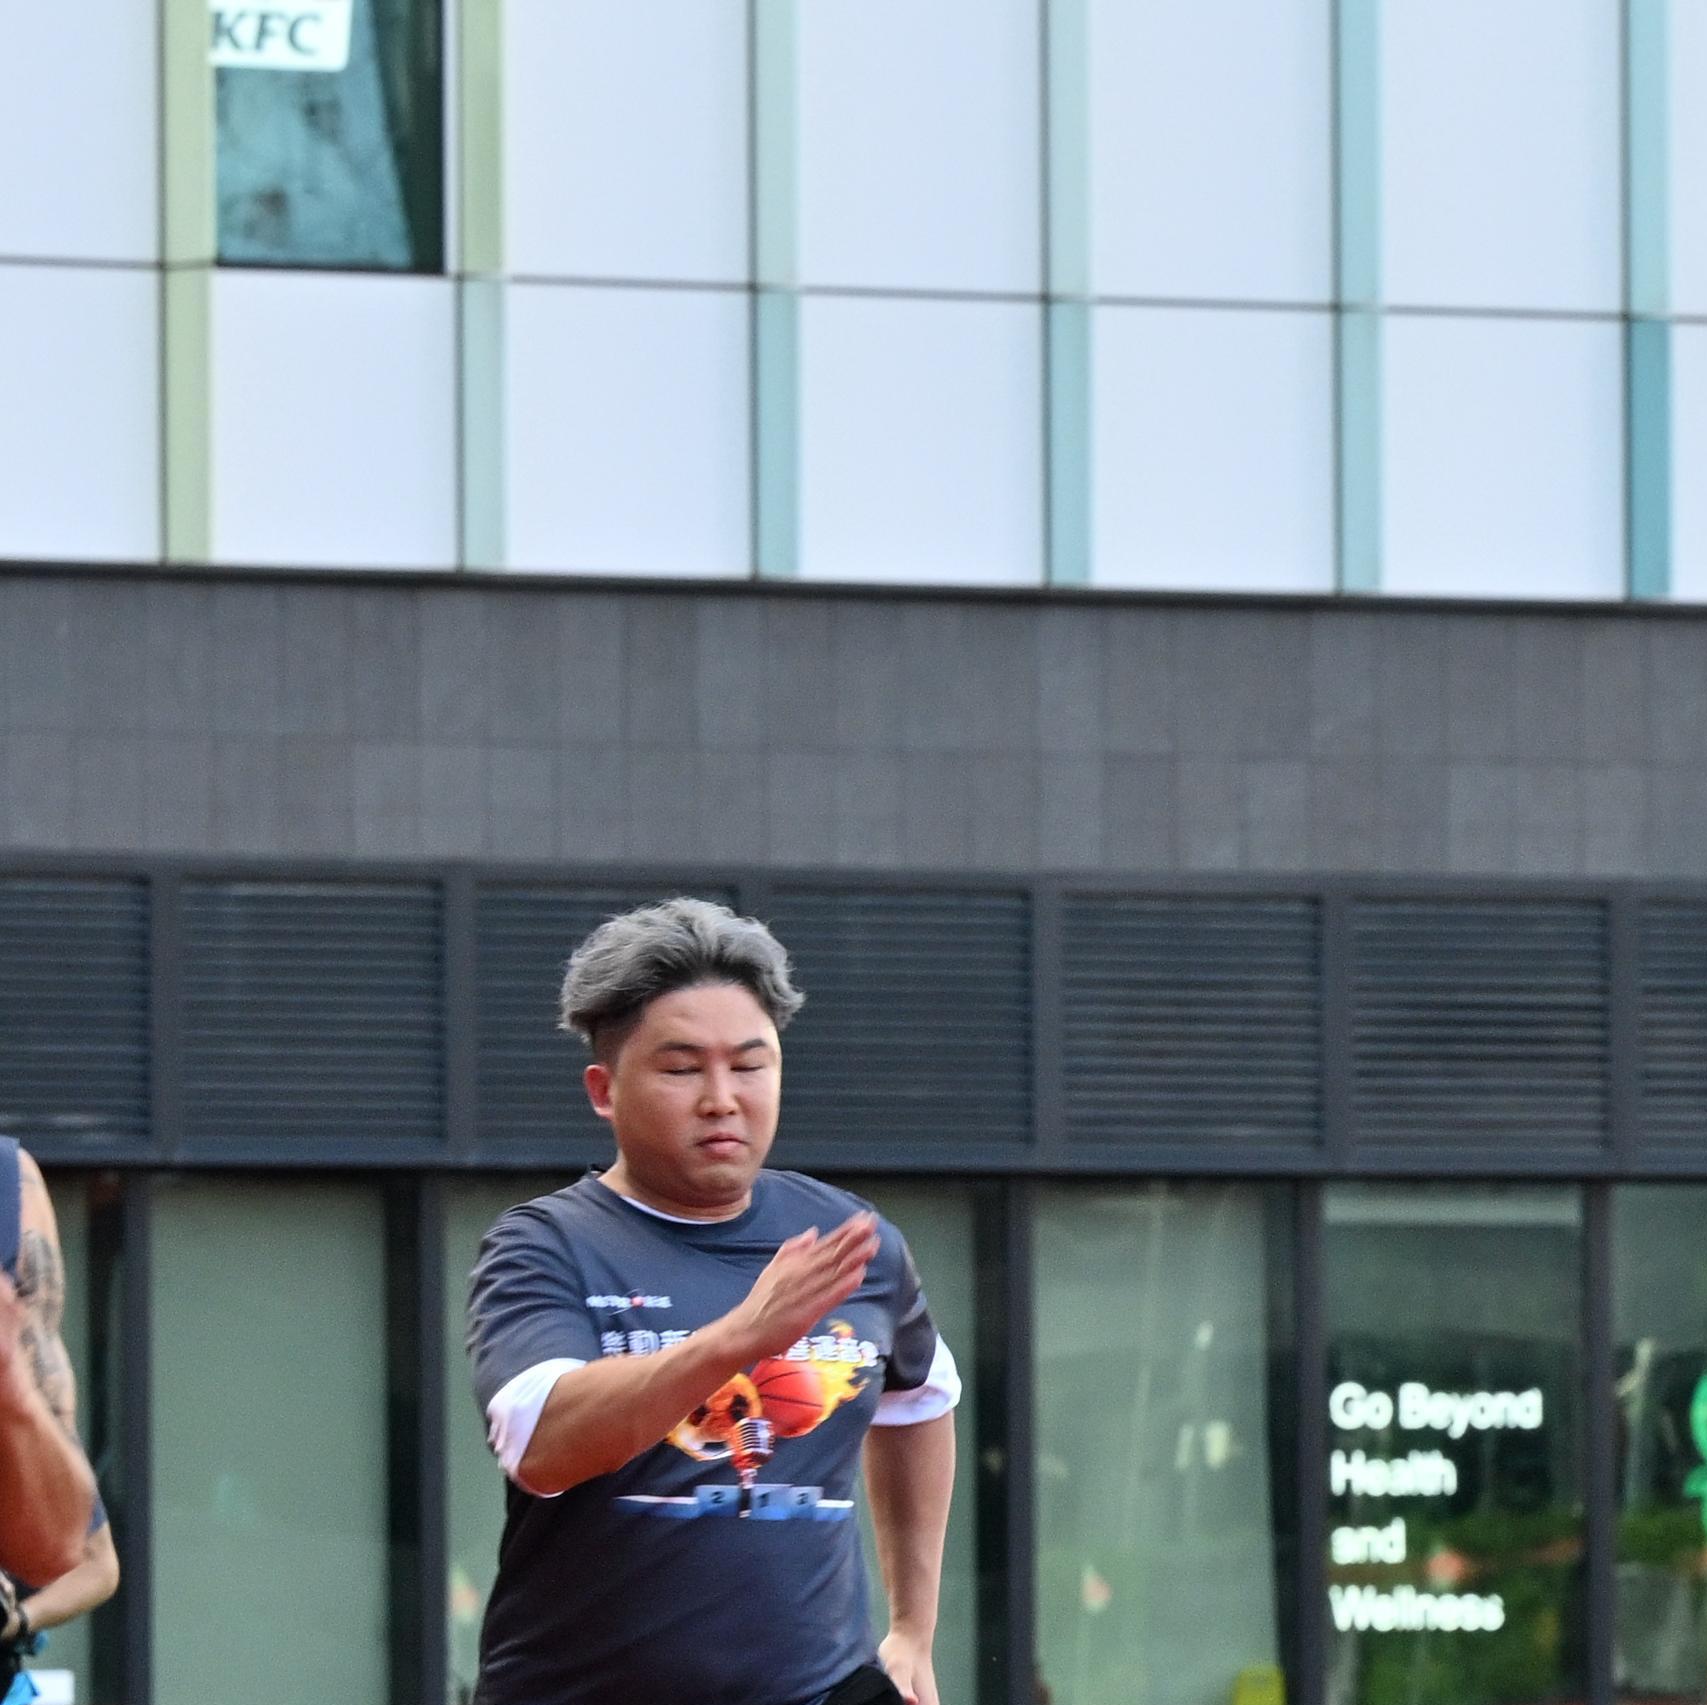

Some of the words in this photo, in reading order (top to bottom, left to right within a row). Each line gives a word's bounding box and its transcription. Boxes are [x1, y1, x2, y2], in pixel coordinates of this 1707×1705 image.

[212, 11, 321, 55] KFC
[1329, 1381, 1394, 1430] Go
[1330, 1517, 1406, 1565] and
